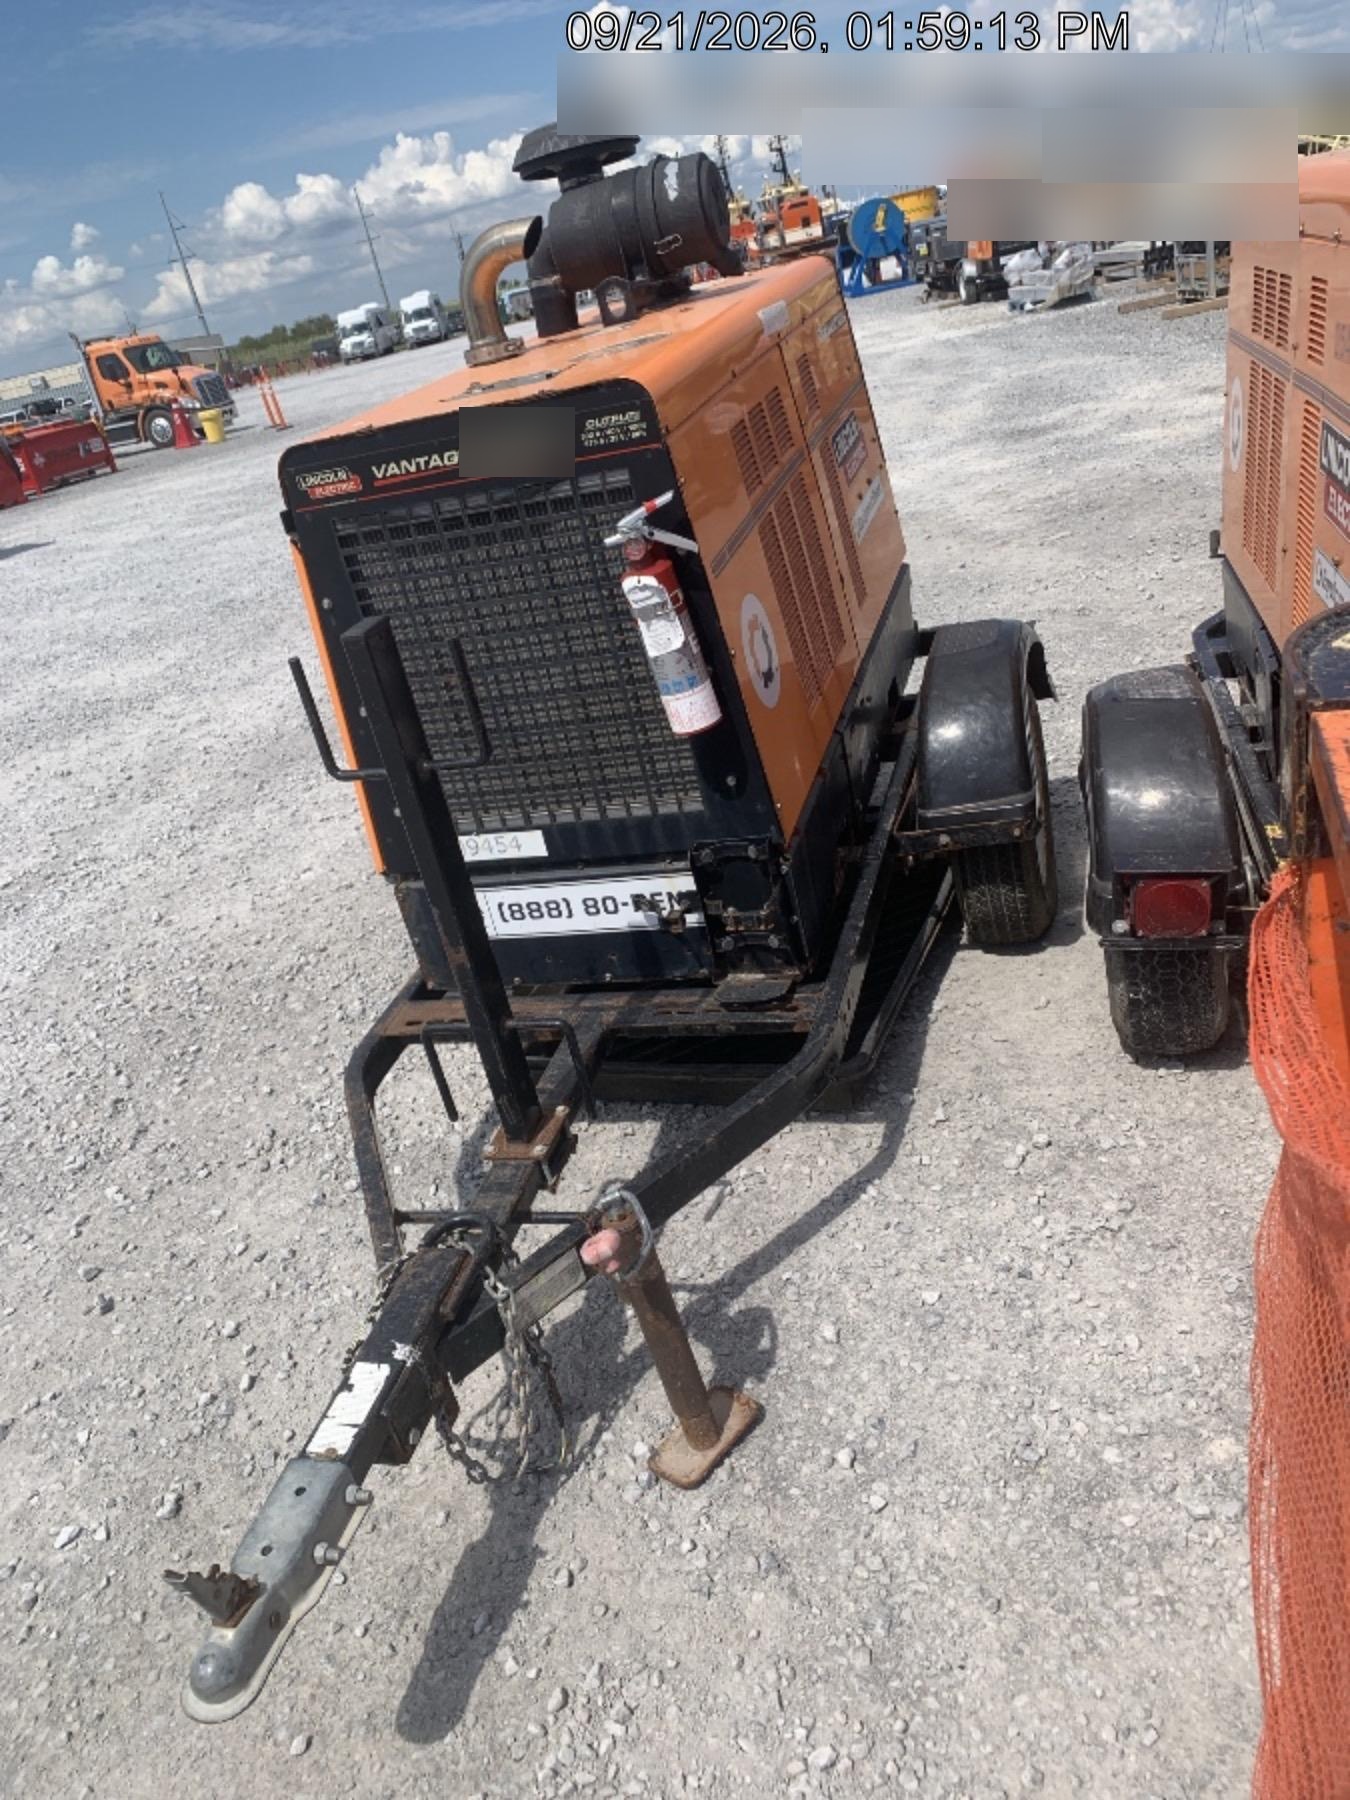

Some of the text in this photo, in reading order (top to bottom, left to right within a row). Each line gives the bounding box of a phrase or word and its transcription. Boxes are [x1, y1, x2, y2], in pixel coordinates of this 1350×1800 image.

[371, 451, 459, 479] VANTAG
[497, 889, 697, 923] (888) 80-REN
